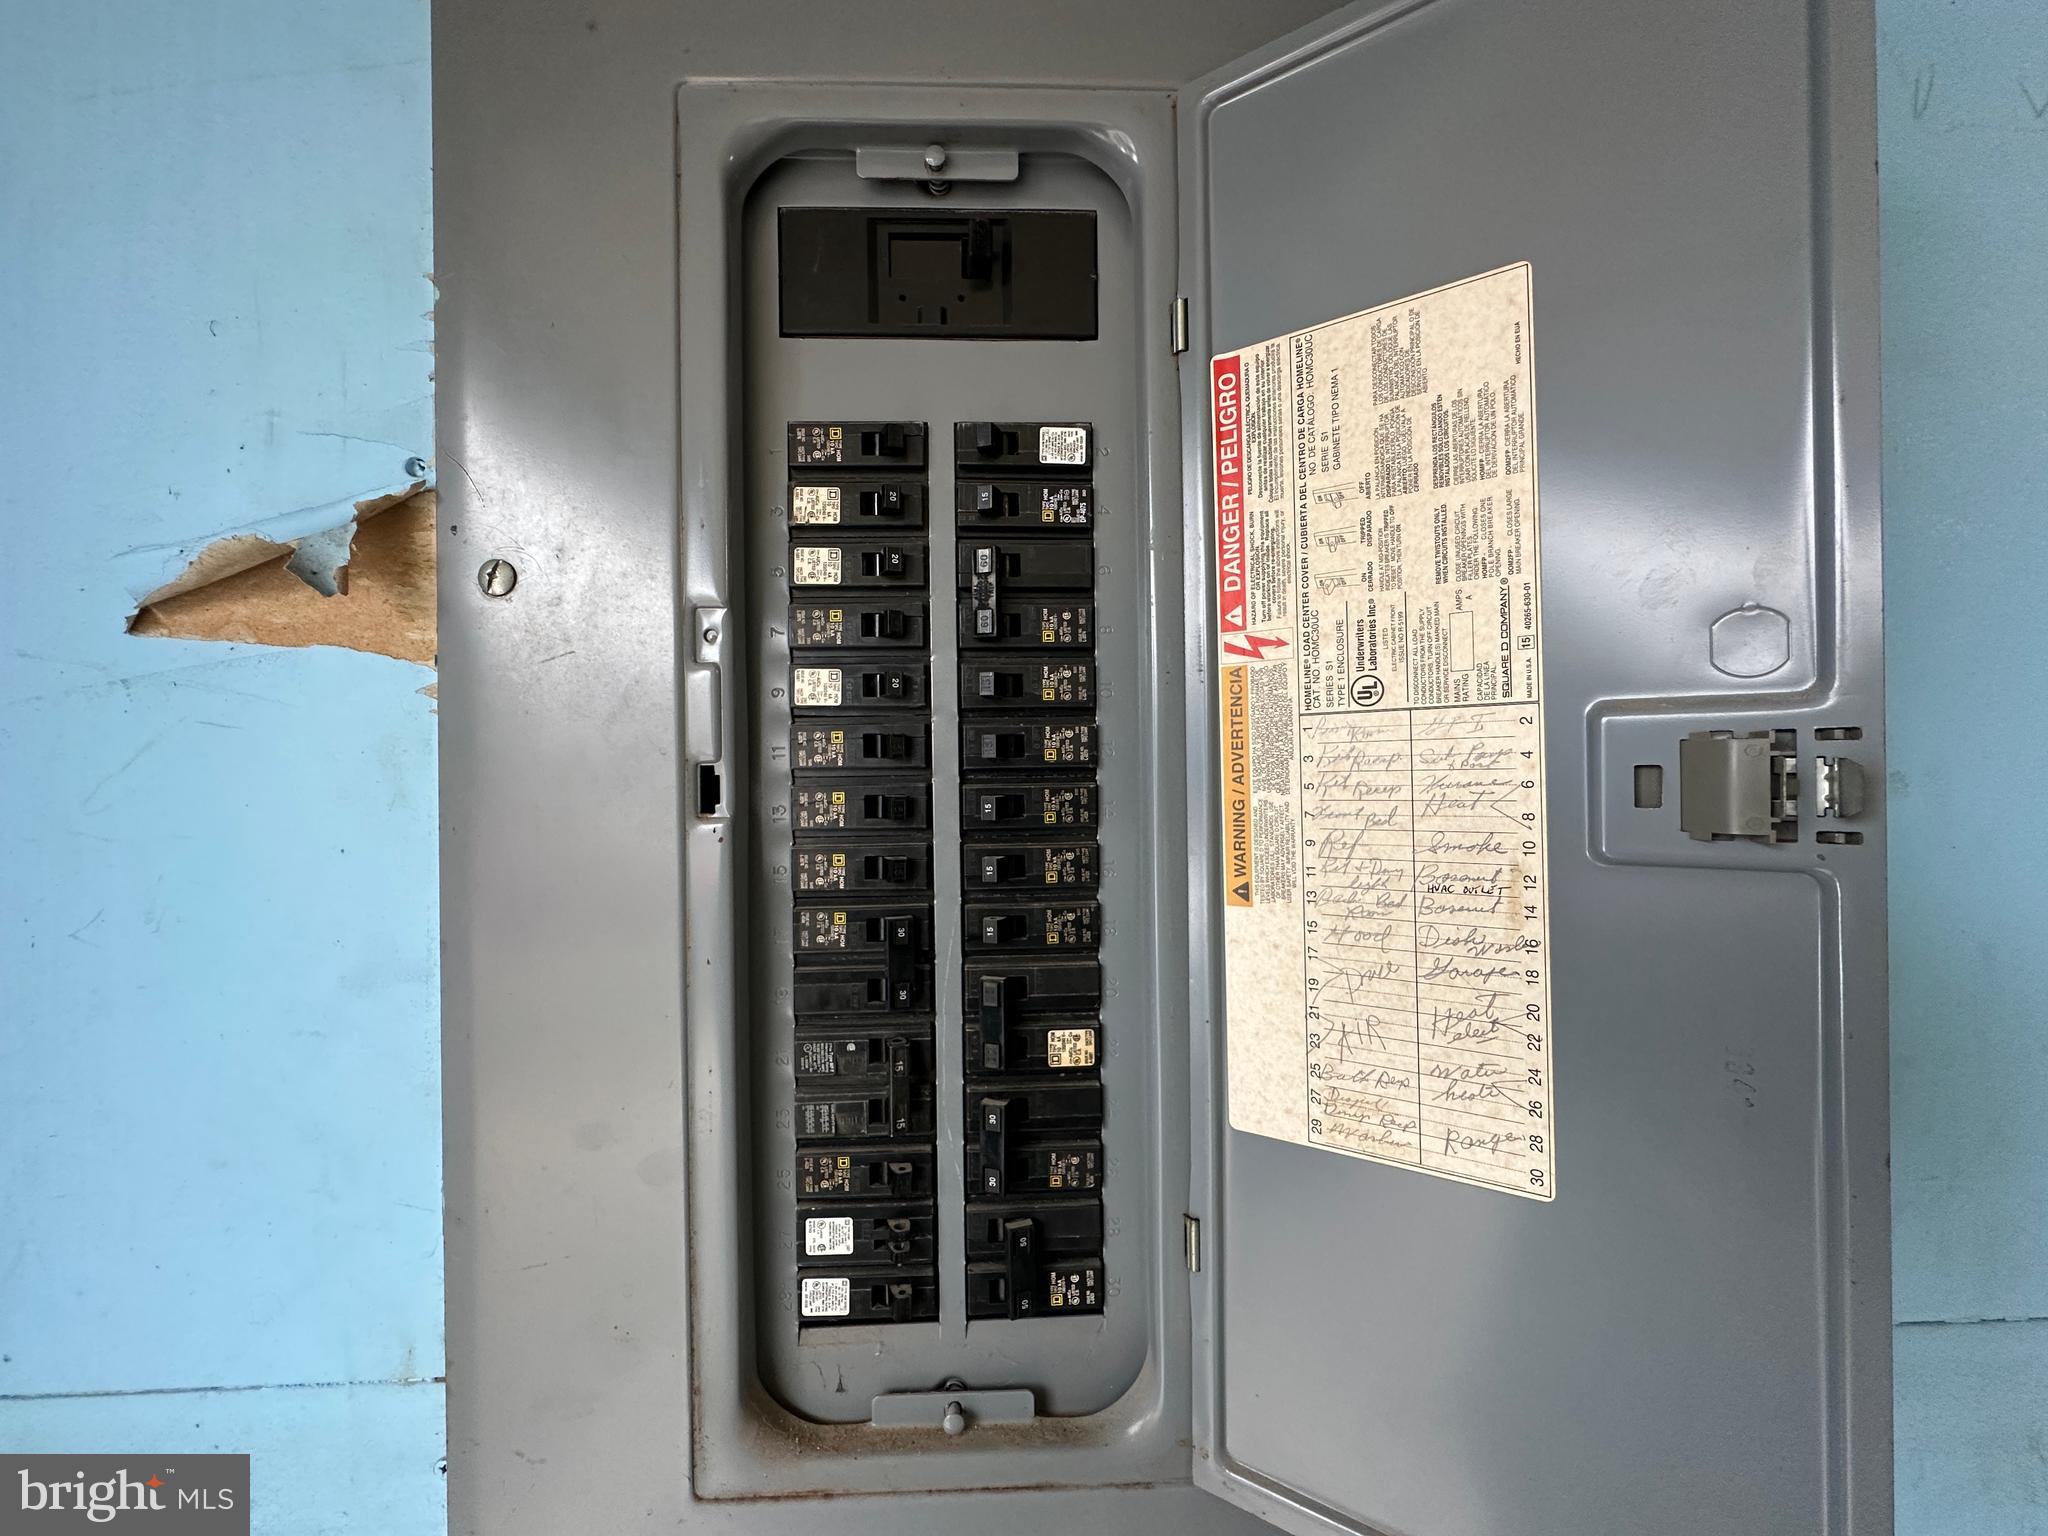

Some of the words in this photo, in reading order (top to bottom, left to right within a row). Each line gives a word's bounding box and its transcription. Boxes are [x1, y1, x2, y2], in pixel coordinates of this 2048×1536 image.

[1515, 334, 1521, 343] EN
[1304, 334, 1314, 389] HOMC30UC
[1330, 374, 1339, 401] NEMA
[1297, 391, 1305, 425] CARGA
[1331, 402, 1340, 424] TIPO
[1218, 373, 1238, 475] PELIGRO
[1297, 427, 1306, 440] DE
[1320, 431, 1329, 442] S1
[1308, 445, 1316, 458] DE
[1331, 425, 1341, 471] GABINETE
[1298, 442, 1307, 481] CENTRO
[1321, 446, 1330, 473] SERIE
[889, 491, 897, 502] 20
[981, 492, 989, 501] 15
[1299, 482, 1307, 501] DEL
[1299, 502, 1308, 550] CUBIERTA
[1222, 493, 1241, 592] DANGER
[891, 553, 899, 564] 20
[980, 554, 988, 568] 60
[1301, 557, 1309, 589] COVER
[1301, 591, 1310, 629] CENTER
[1523, 582, 1532, 630] 40265-630-01
[980, 615, 989, 628] 60
[770, 626, 785, 638] 7
[1310, 609, 1320, 664] HOMC30UC
[1302, 631, 1311, 657] LOAD
[1336, 619, 1345, 674] ENCLOSURE
[1355, 619, 1365, 672] Underwriters
[1520, 637, 1531, 650] 15
[1325, 660, 1334, 671] S1
[892, 678, 900, 688] 20
[1461, 673, 1470, 702] RATING
[1476, 662, 1484, 701] CAPACIDAD
[771, 687, 785, 698] 9
[1325, 675, 1335, 708] SERIES
[1337, 684, 1345, 707] TYPE
[1356, 680, 1379, 701] UL
[1453, 678, 1461, 703] MAINS
[1229, 666, 1245, 786] ADVERTENCIA
[1518, 715, 1533, 725] 2
[771, 746, 786, 760] 11
[1302, 754, 1314, 763] 3
[1519, 750, 1534, 760] 4
[1303, 782, 1314, 790] 5
[1520, 780, 1535, 789] 6
[772, 804, 787, 823] 13
[984, 803, 992, 813] 15
[1303, 810, 1315, 818] 7
[1521, 812, 1536, 821] 8
[1232, 799, 1247, 878] WARNING
[1304, 839, 1316, 847] 9
[1521, 840, 1537, 857] 10
[772, 864, 788, 883] 15
[986, 865, 994, 875] 15
[1305, 865, 1316, 878] 11
[1427, 884, 1455, 893] HVAC
[1463, 884, 1512, 895] OUTLET
[1522, 874, 1537, 891] 12
[1305, 890, 1317, 905] 13
[1523, 904, 1538, 921] 14
[897, 927, 905, 938] 30
[986, 926, 994, 936] 15
[1306, 919, 1318, 935] 15
[1307, 946, 1319, 961] 17
[1524, 938, 1539, 956] 16
[1307, 977, 1319, 993] 19
[1525, 968, 1540, 986] 18
[899, 990, 907, 1000] 30
[1308, 1004, 1320, 1021] 21
[1526, 1002, 1541, 1022] 20
[1309, 1032, 1321, 1049] 23
[1526, 1032, 1542, 1053] 22
[894, 1060, 904, 1072] 15
[1310, 1061, 1321, 1079] 25
[1527, 1066, 1543, 1087] 24
[1310, 1088, 1322, 1105] 27
[1528, 1099, 1543, 1119] 26
[896, 1118, 906, 1129] 15
[989, 1114, 997, 1125] 30
[1311, 1117, 1323, 1136] 29
[1529, 1133, 1544, 1154] 28
[989, 1176, 997, 1187] 30
[1530, 1167, 1545, 1188] 30
[1019, 1237, 1027, 1247] 50
[1021, 1299, 1029, 1310] 50
